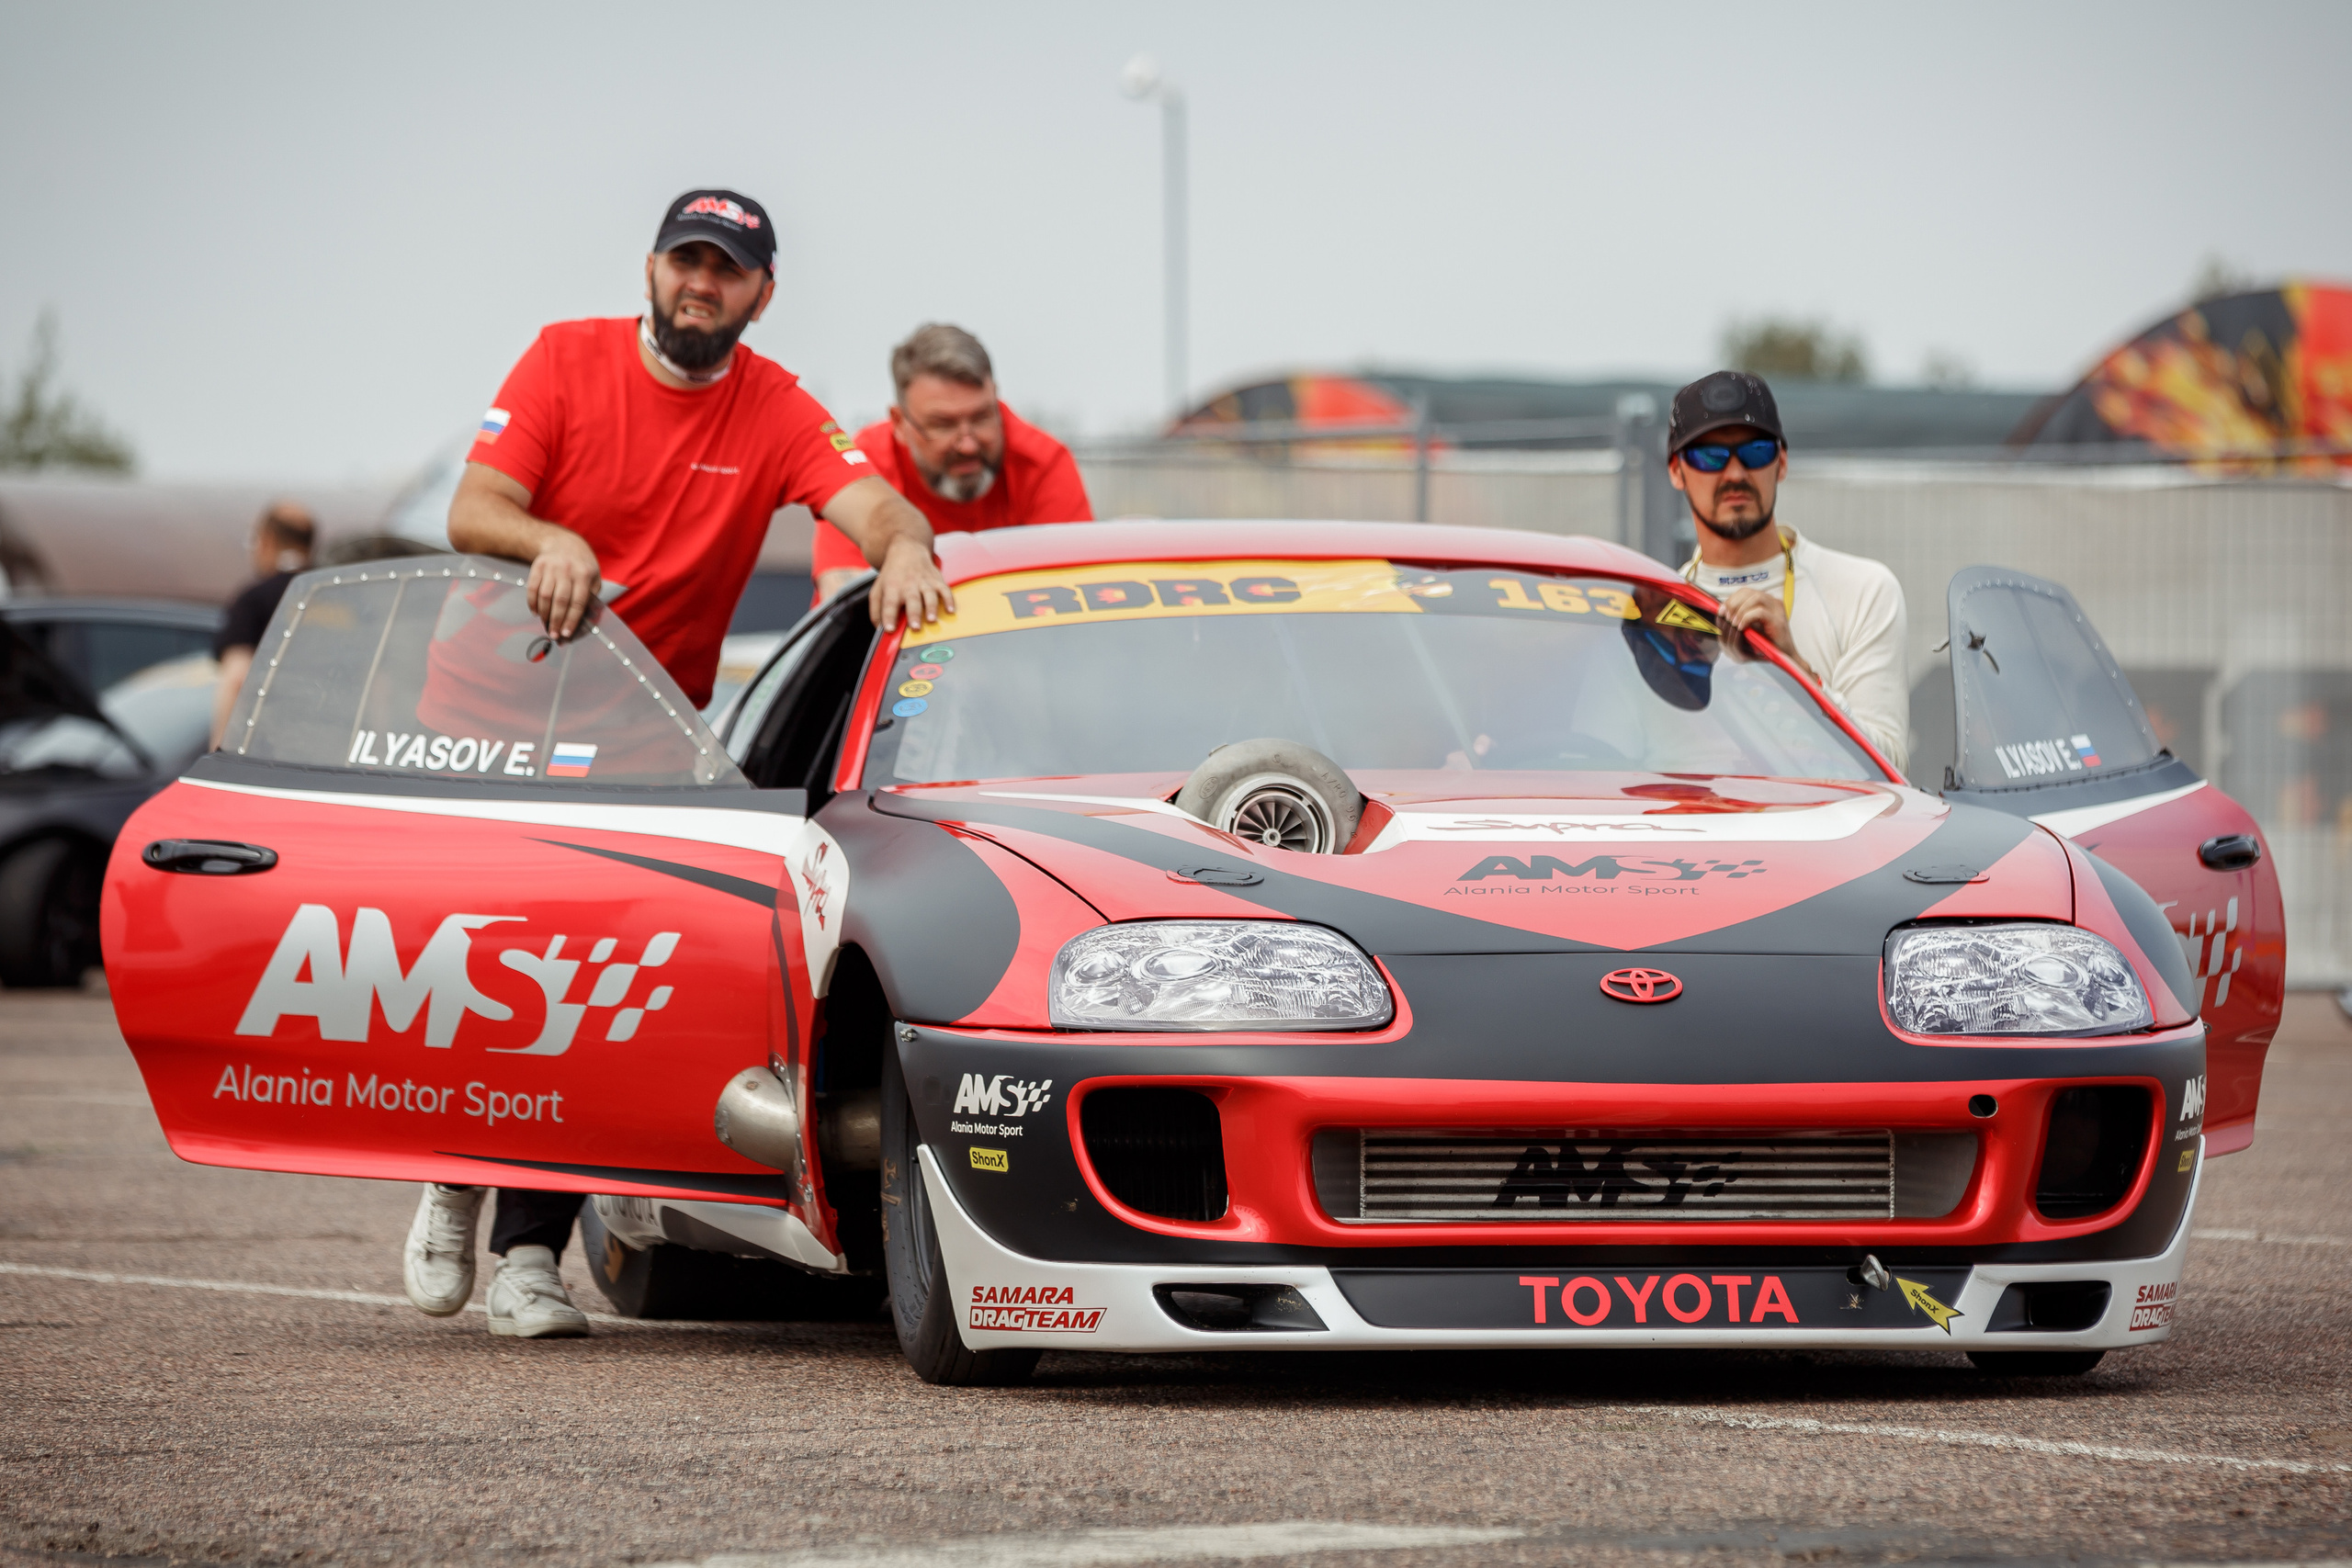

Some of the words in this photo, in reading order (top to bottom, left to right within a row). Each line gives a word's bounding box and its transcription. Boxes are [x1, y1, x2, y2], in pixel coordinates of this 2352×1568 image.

[1001, 577, 1302, 620] RDRC
[1488, 578, 1642, 621] 163
[348, 729, 505, 773] ILYASOV
[503, 740, 536, 777] E.
[1995, 739, 2064, 779] ILYASOV
[1443, 885, 1531, 897] Alania
[1541, 884, 1620, 896] Motor
[1627, 885, 1701, 897] Sport
[212, 1064, 334, 1107] Alania
[345, 1072, 456, 1115] Motor
[463, 1080, 565, 1126] Sport
[953, 1073, 1029, 1118] AMS
[950, 1120, 974, 1134] Alania
[974, 1122, 998, 1135] Motor
[999, 1123, 1023, 1138] Sport
[971, 1150, 1005, 1168] ShonX
[972, 1286, 1074, 1304] SAMARA
[1519, 1273, 1800, 1326] TOYOTA
[1910, 1289, 1939, 1314] ShonX
